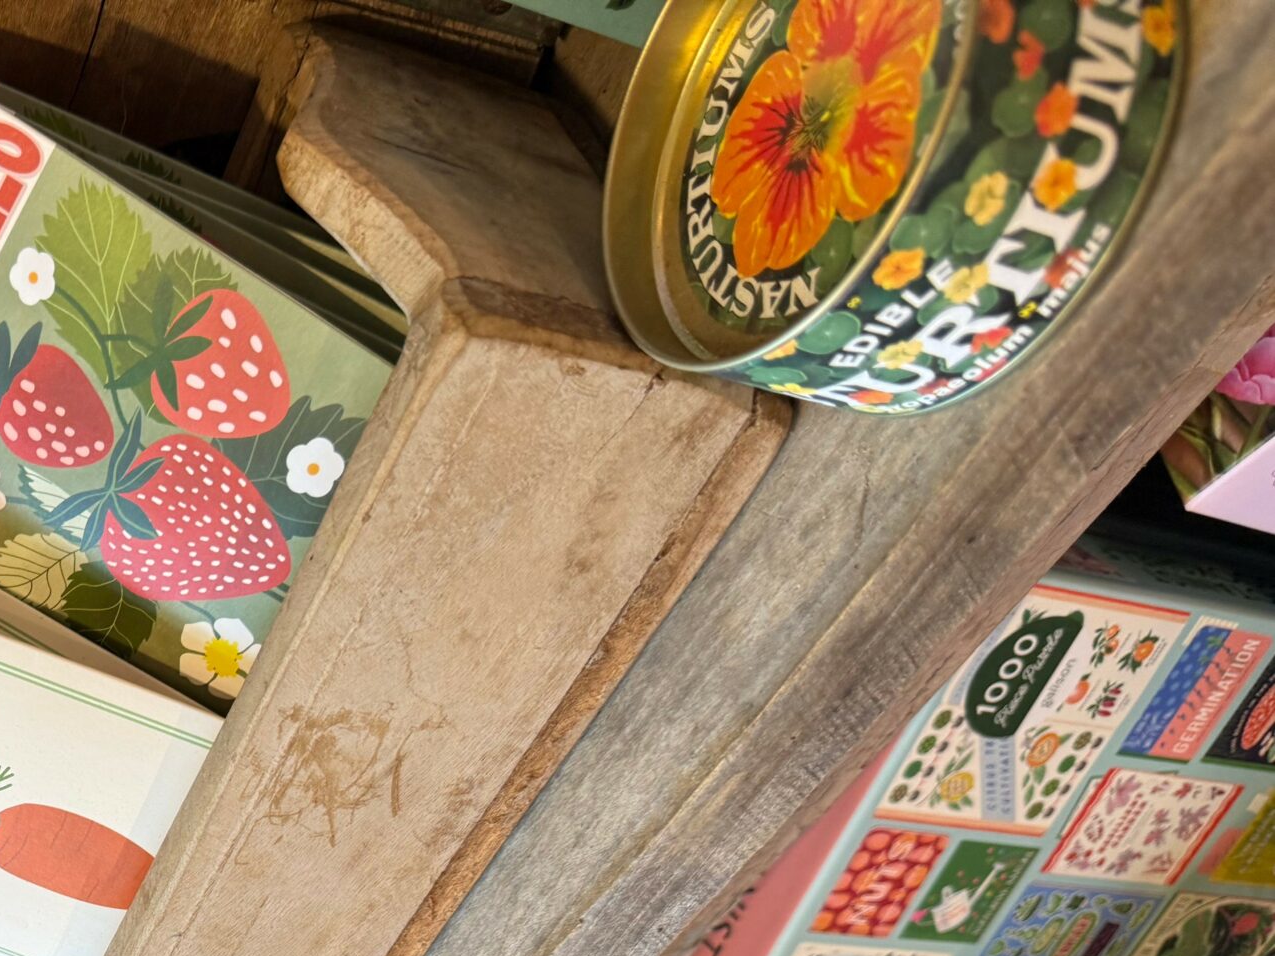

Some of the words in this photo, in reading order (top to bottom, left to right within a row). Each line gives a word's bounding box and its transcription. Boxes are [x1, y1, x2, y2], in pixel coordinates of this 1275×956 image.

[686, 1, 822, 319] NASTURTIUMS
[829, 259, 955, 369] EDIBLE
[1036, 223, 1112, 319] majus
[976, 633, 1040, 716] 1000
[994, 683, 1029, 729] Piece
[1022, 628, 1065, 685] Puzzle
[1173, 638, 1262, 754] GERMINATION
[846, 843, 914, 925] NUTS
